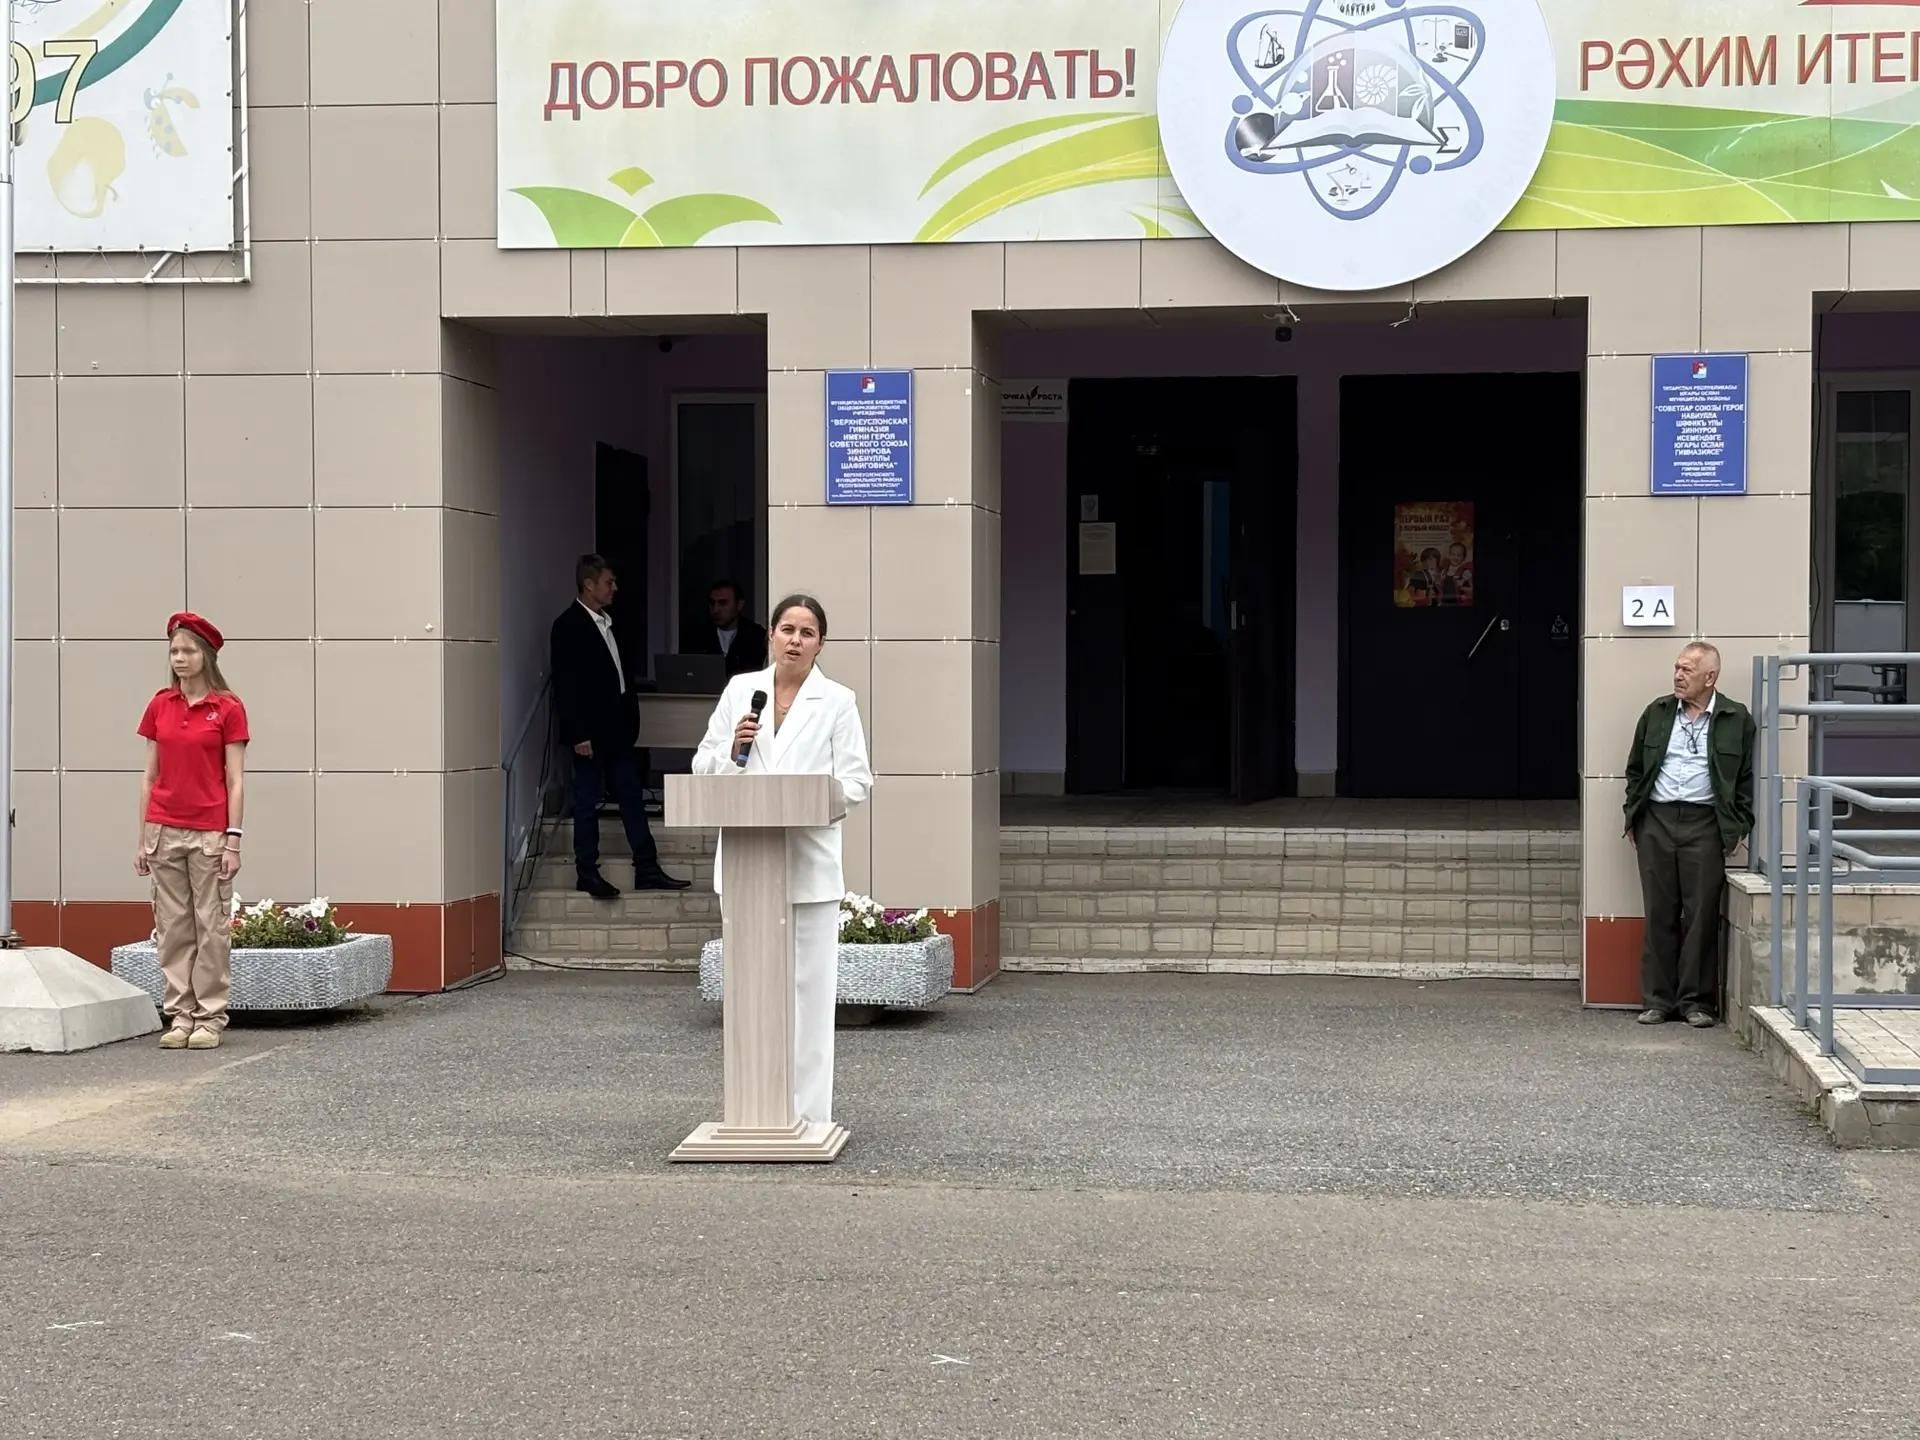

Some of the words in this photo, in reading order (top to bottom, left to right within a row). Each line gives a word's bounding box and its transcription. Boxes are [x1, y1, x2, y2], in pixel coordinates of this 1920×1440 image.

[1580, 34, 1777, 91] РӘХИМ
[544, 58, 728, 121] ДОБРО
[744, 48, 1136, 107] ПОЖАЛОВАТЬ!
[829, 440, 879, 448] СОВЕТСКОГО
[1632, 599, 1644, 617] 2
[1653, 599, 1670, 617] А
